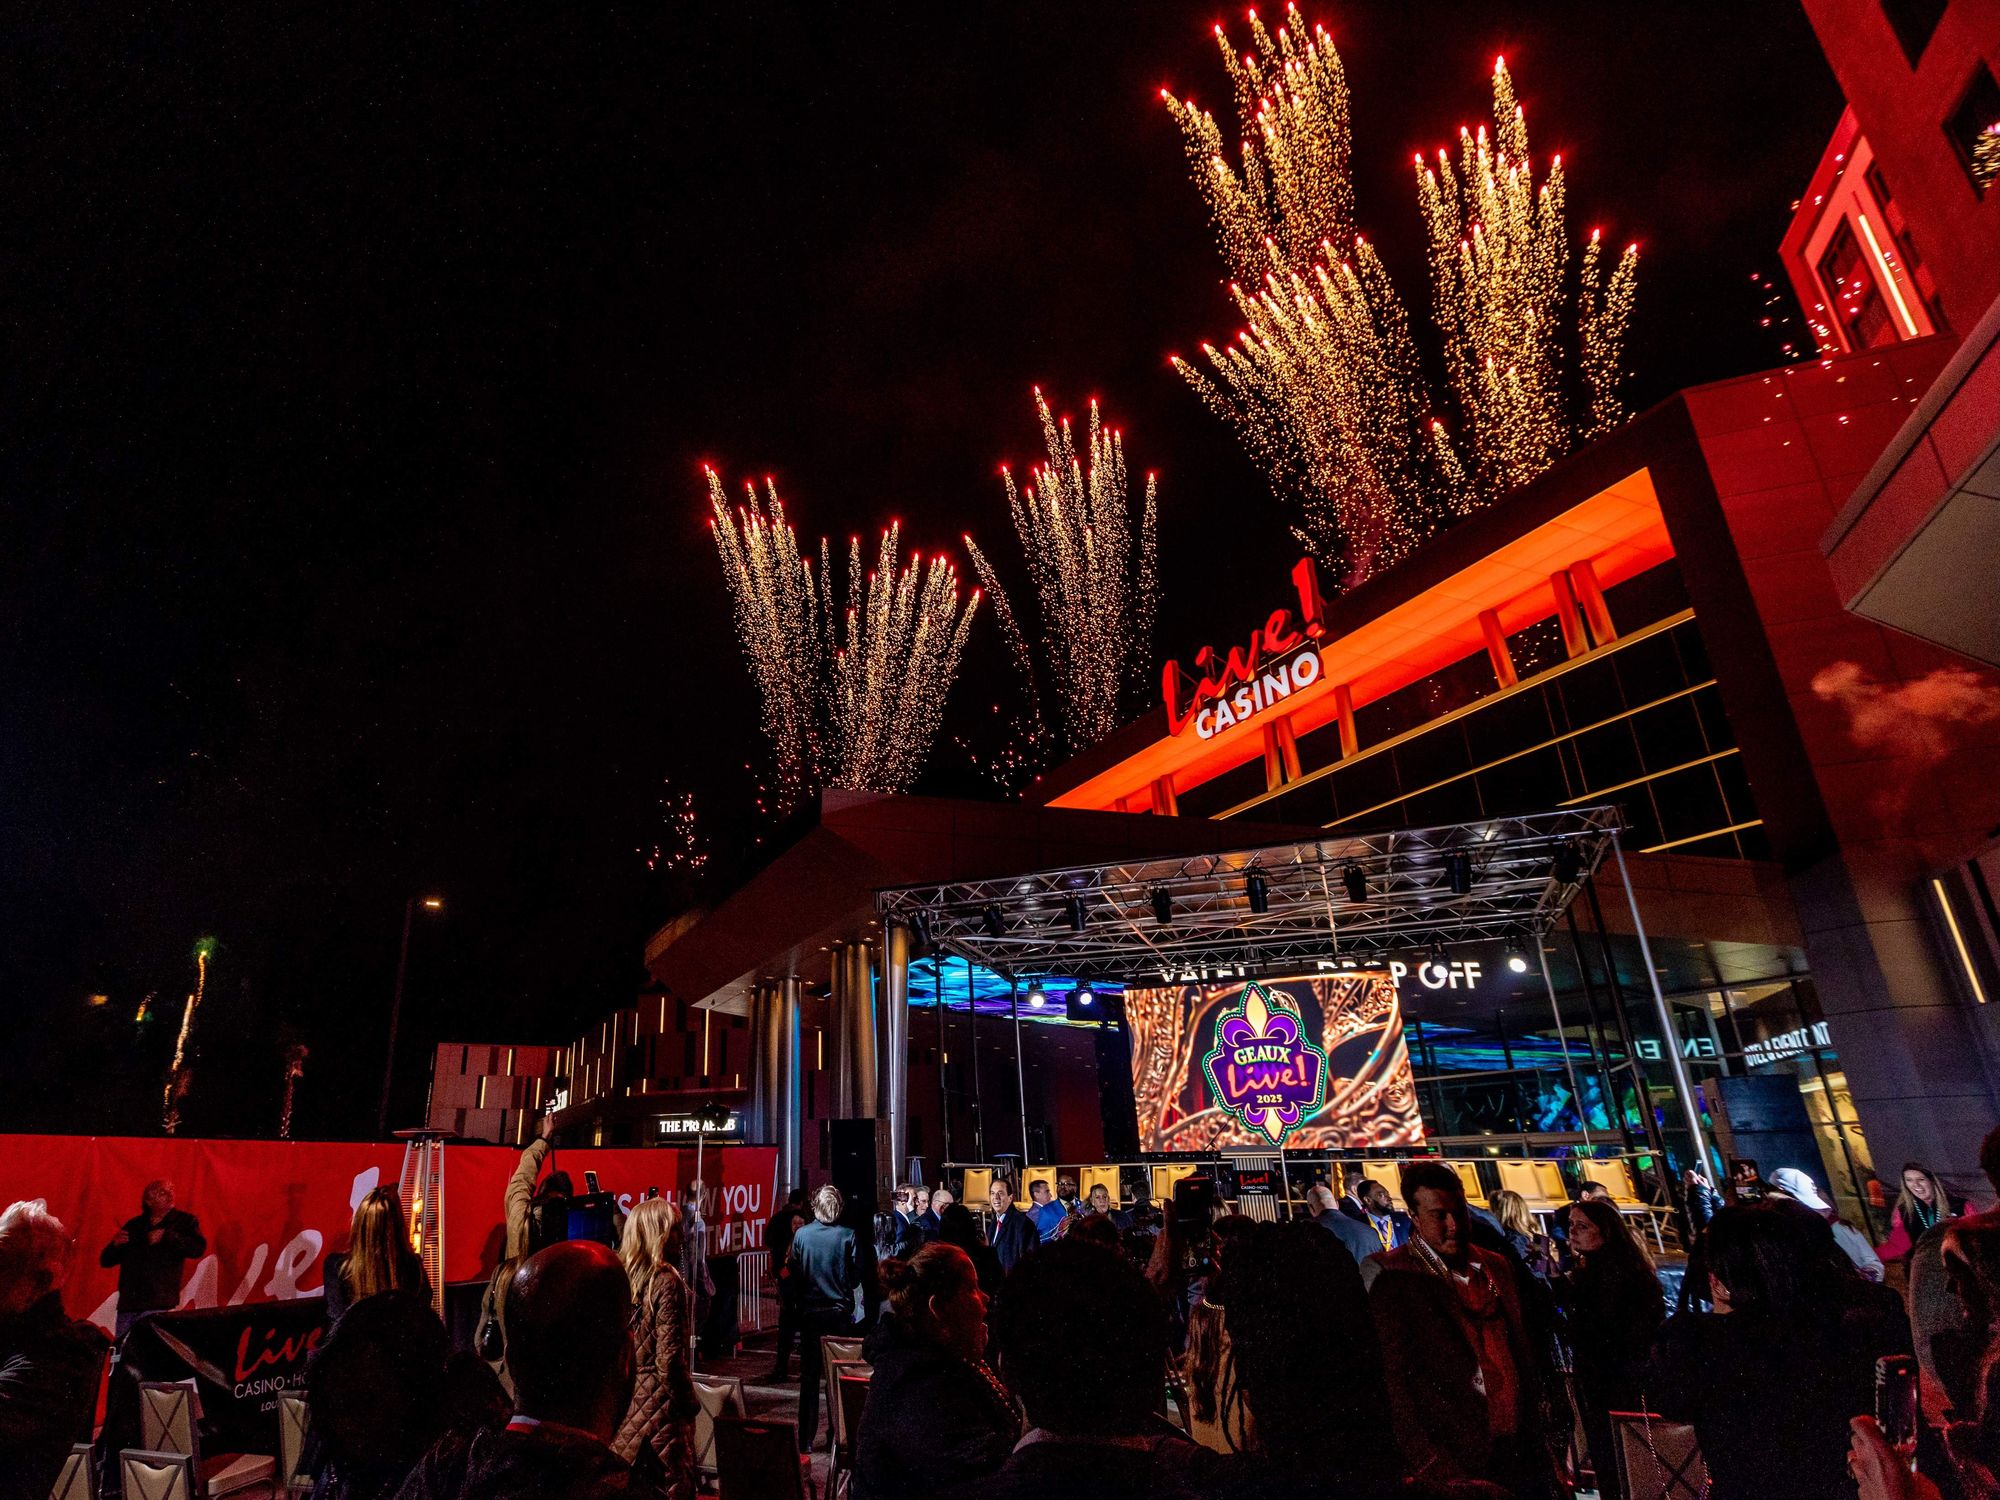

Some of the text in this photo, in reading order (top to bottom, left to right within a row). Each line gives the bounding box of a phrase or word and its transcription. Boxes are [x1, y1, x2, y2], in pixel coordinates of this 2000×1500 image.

[1162, 557, 1326, 736] Live!
[1195, 652, 1320, 740] CASINO
[1418, 961, 1482, 989] OFF
[1233, 1045, 1292, 1066] GEAUX
[1227, 1055, 1309, 1098] Live!
[1256, 1094, 1283, 1104] 2025
[659, 1120, 681, 1133] THE
[1239, 1172, 1269, 1186] Live!
[722, 1183, 761, 1216] YOU
[234, 1376, 284, 1399] CASINO
